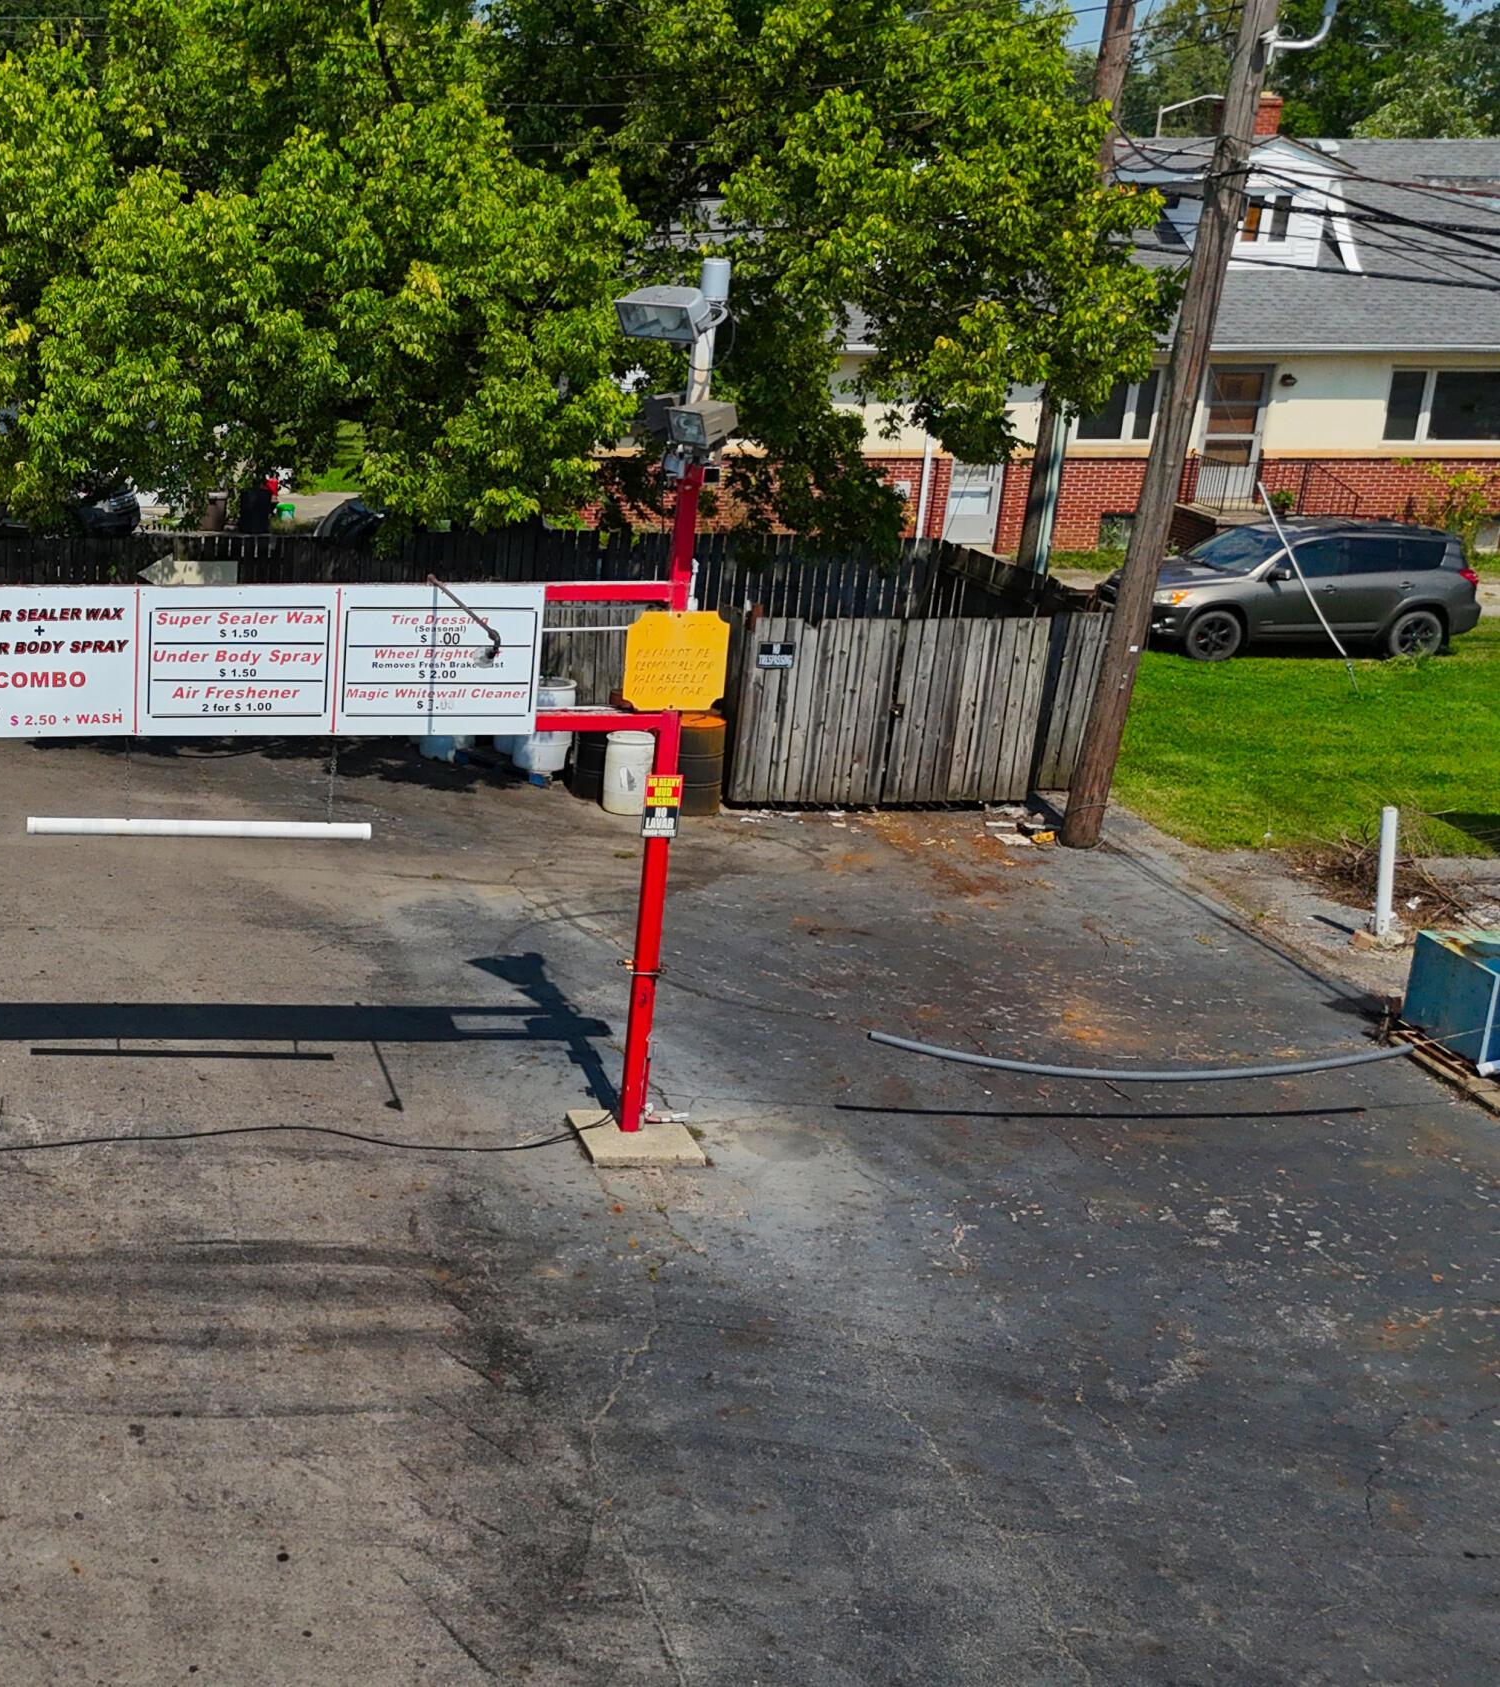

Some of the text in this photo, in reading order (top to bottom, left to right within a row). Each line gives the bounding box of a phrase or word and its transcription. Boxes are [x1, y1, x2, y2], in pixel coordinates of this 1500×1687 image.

[16, 609, 82, 622] SEALER
[86, 608, 125, 621] WAX
[156, 612, 324, 627] Super Sealer Wax
[392, 615, 419, 625] Tire
[35, 625, 45, 636] +
[220, 629, 258, 638] $ 1.50
[415, 625, 466, 633] (Seasonal)
[421, 635, 427, 643] $
[14, 641, 65, 654] BODY
[70, 640, 129, 654] SPRAY
[153, 650, 322, 665] Under Body Spray
[374, 649, 502, 661] Wheel Brighter
[219, 669, 257, 678] $ 1.50
[419, 670, 457, 679] $ 2.00
[172, 687, 300, 699] Air Freshener
[346, 689, 527, 701] Magic Whitewall Cleaner
[202, 703, 272, 712] 2 for $ 1.00
[417, 701, 423, 709] $
[10, 715, 19, 726] $
[25, 715, 57, 725] 2.50
[76, 714, 123, 724] WASH
[649, 778, 657, 786] NO
[655, 787, 672, 796] MUD
[647, 797, 678, 806] WASHING
[655, 807, 667, 817] NO
[645, 818, 674, 828] LAVAR
